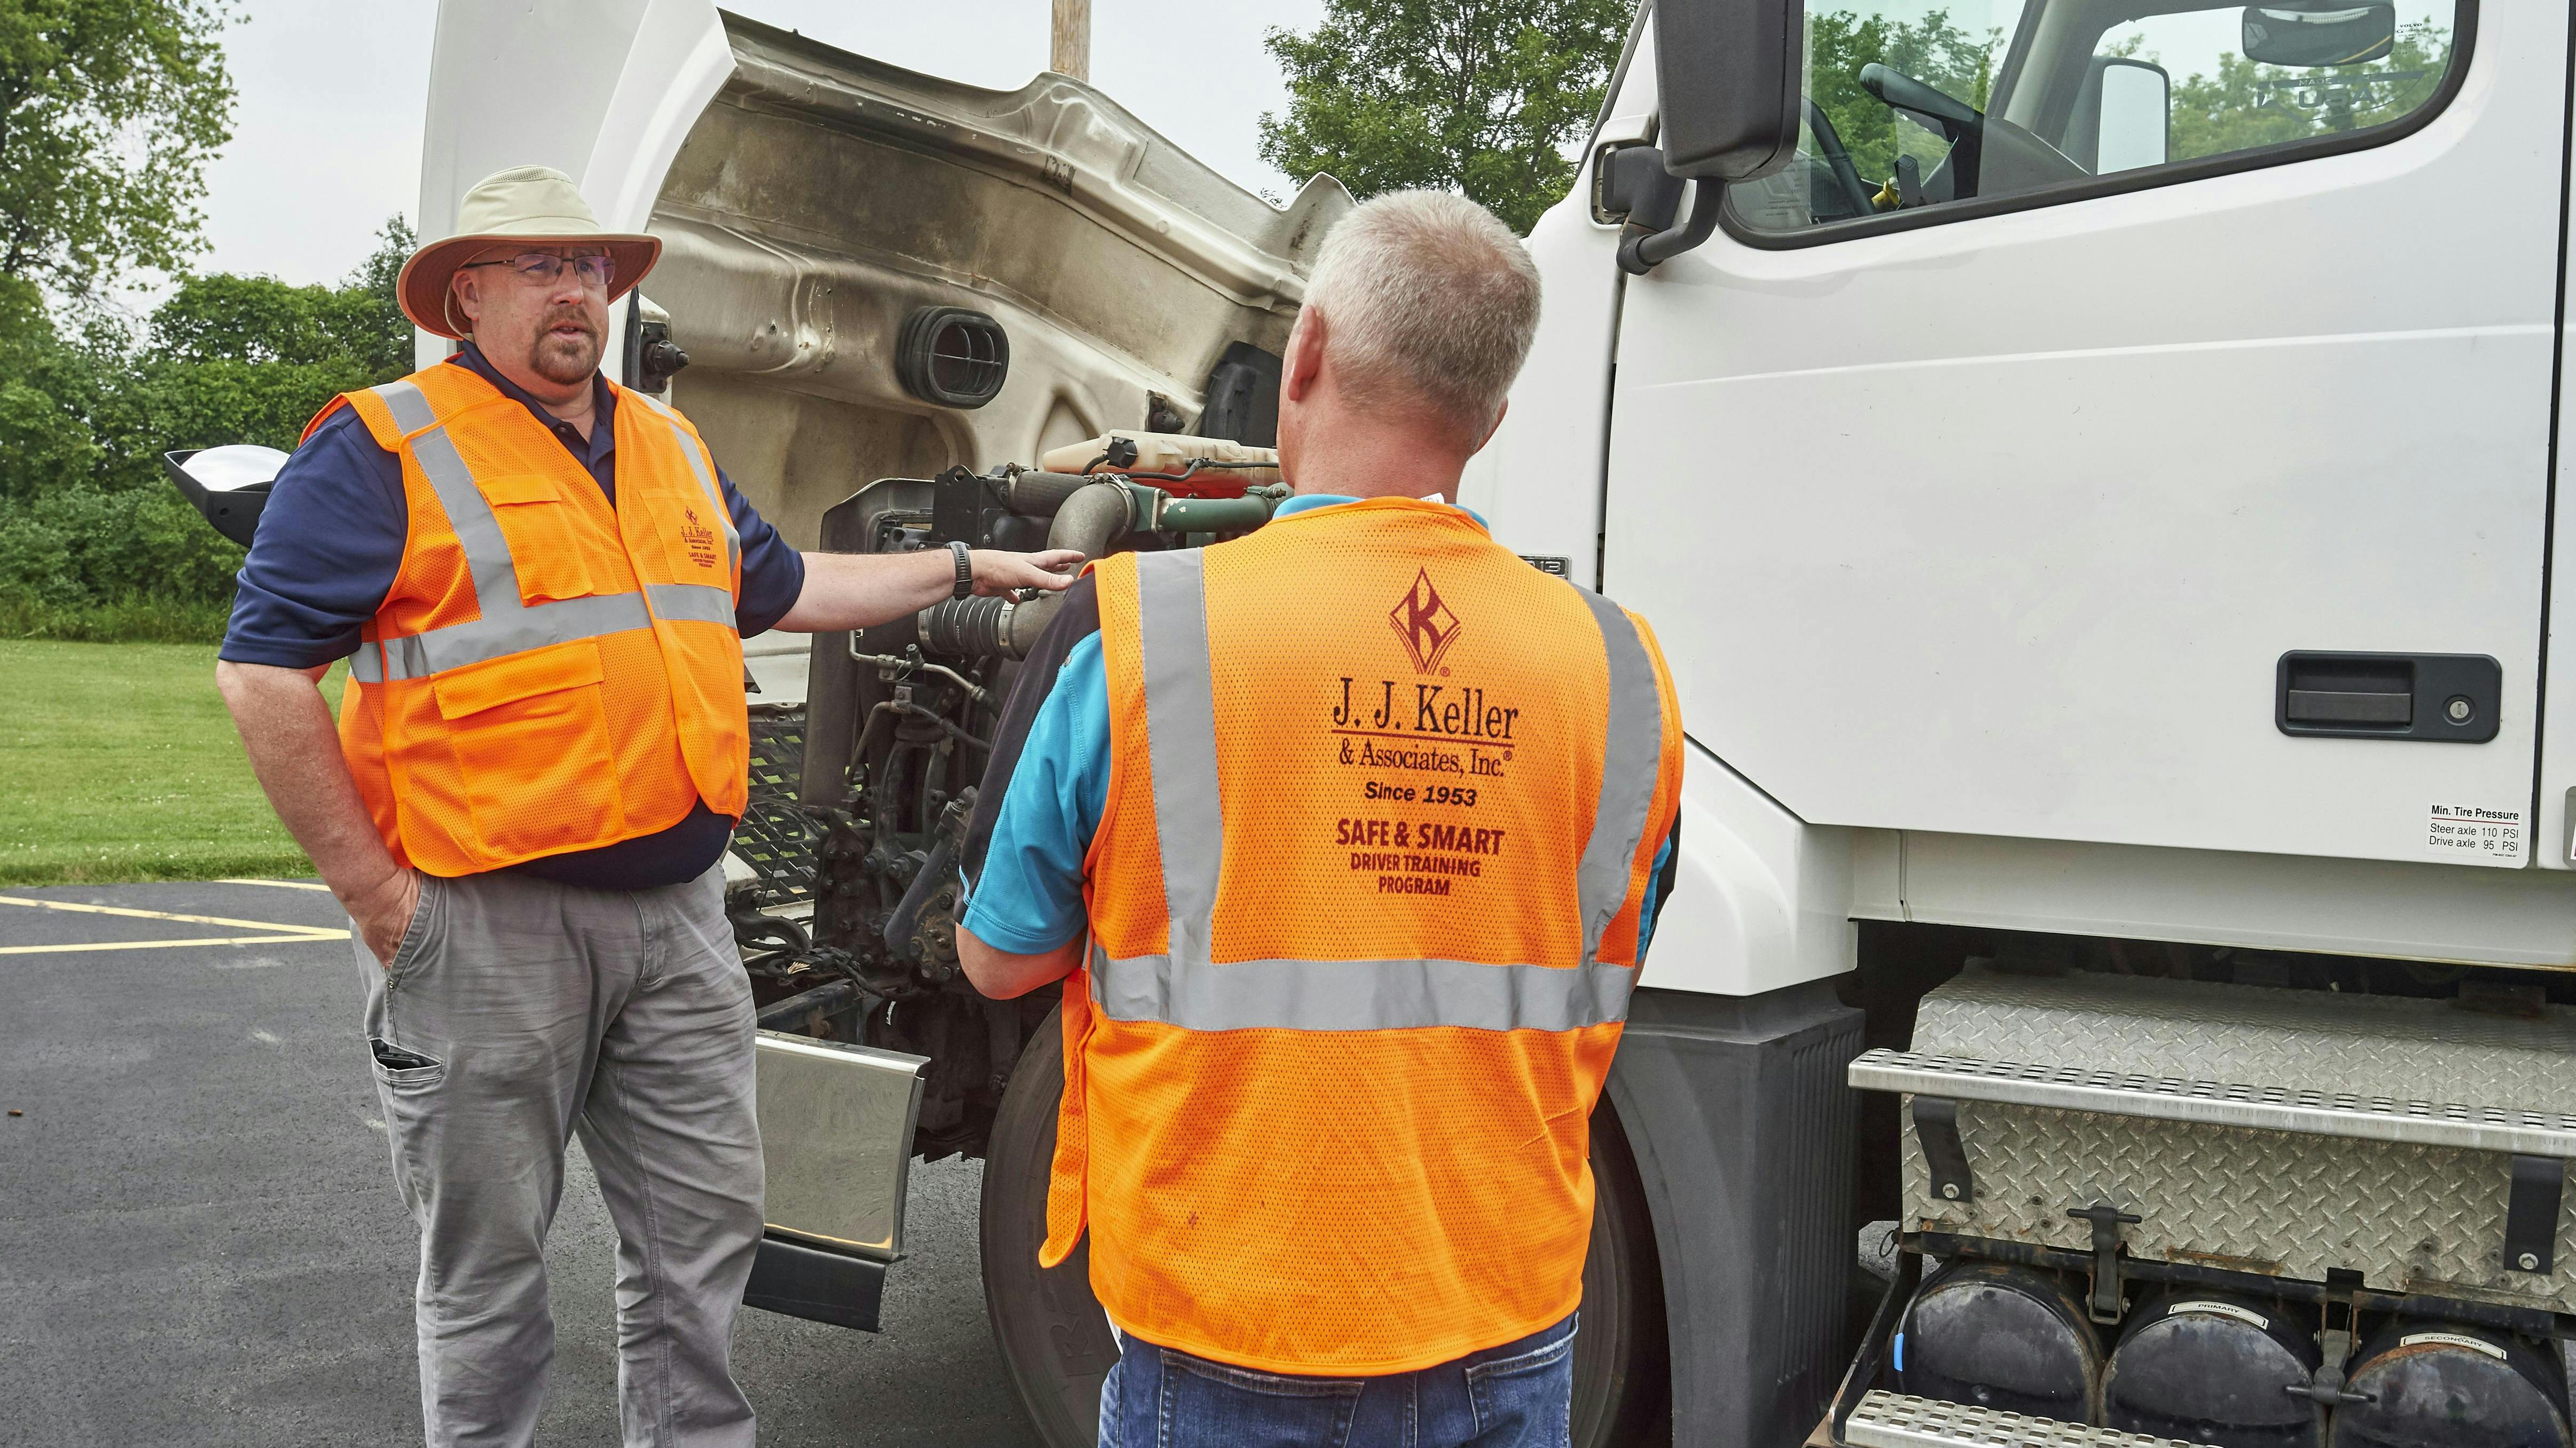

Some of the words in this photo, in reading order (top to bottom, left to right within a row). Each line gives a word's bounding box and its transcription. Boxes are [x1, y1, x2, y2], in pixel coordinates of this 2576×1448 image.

[2299, 77, 2332, 86] MADE
[2299, 89, 2378, 108] USA
[695, 526, 712, 538] Keller
[1334, 677, 1360, 728] J.
[1374, 681, 1400, 730] J.
[1414, 684, 1518, 739] Keller
[1339, 738, 1354, 765] &
[1359, 738, 1464, 778] Associates,
[1364, 782, 1415, 801] Since
[1423, 785, 1477, 807] 1953
[2431, 805, 2451, 815] Min.
[2454, 807, 2472, 817] Tire
[2475, 808, 2519, 820] Pressure
[1336, 819, 1389, 846] SAFE
[1394, 821, 1411, 848] &
[1417, 823, 1506, 856] SMART
[2430, 823, 2455, 833] Steer
[2457, 826, 2477, 836] axle
[2482, 827, 2497, 837] 110
[2503, 828, 2519, 838] PSI
[2429, 835, 2454, 846] Drive
[2456, 838, 2476, 848] axle
[2484, 840, 2494, 850] 95
[2502, 841, 2518, 852] PSI
[1350, 852, 1400, 872] DRIVER
[1403, 855, 1481, 877] TRAINING
[1379, 875, 1451, 896] PROGRAM
[2198, 1304, 2240, 1313] PRIMARY
[2425, 1336, 2483, 1347] SECONDARY
